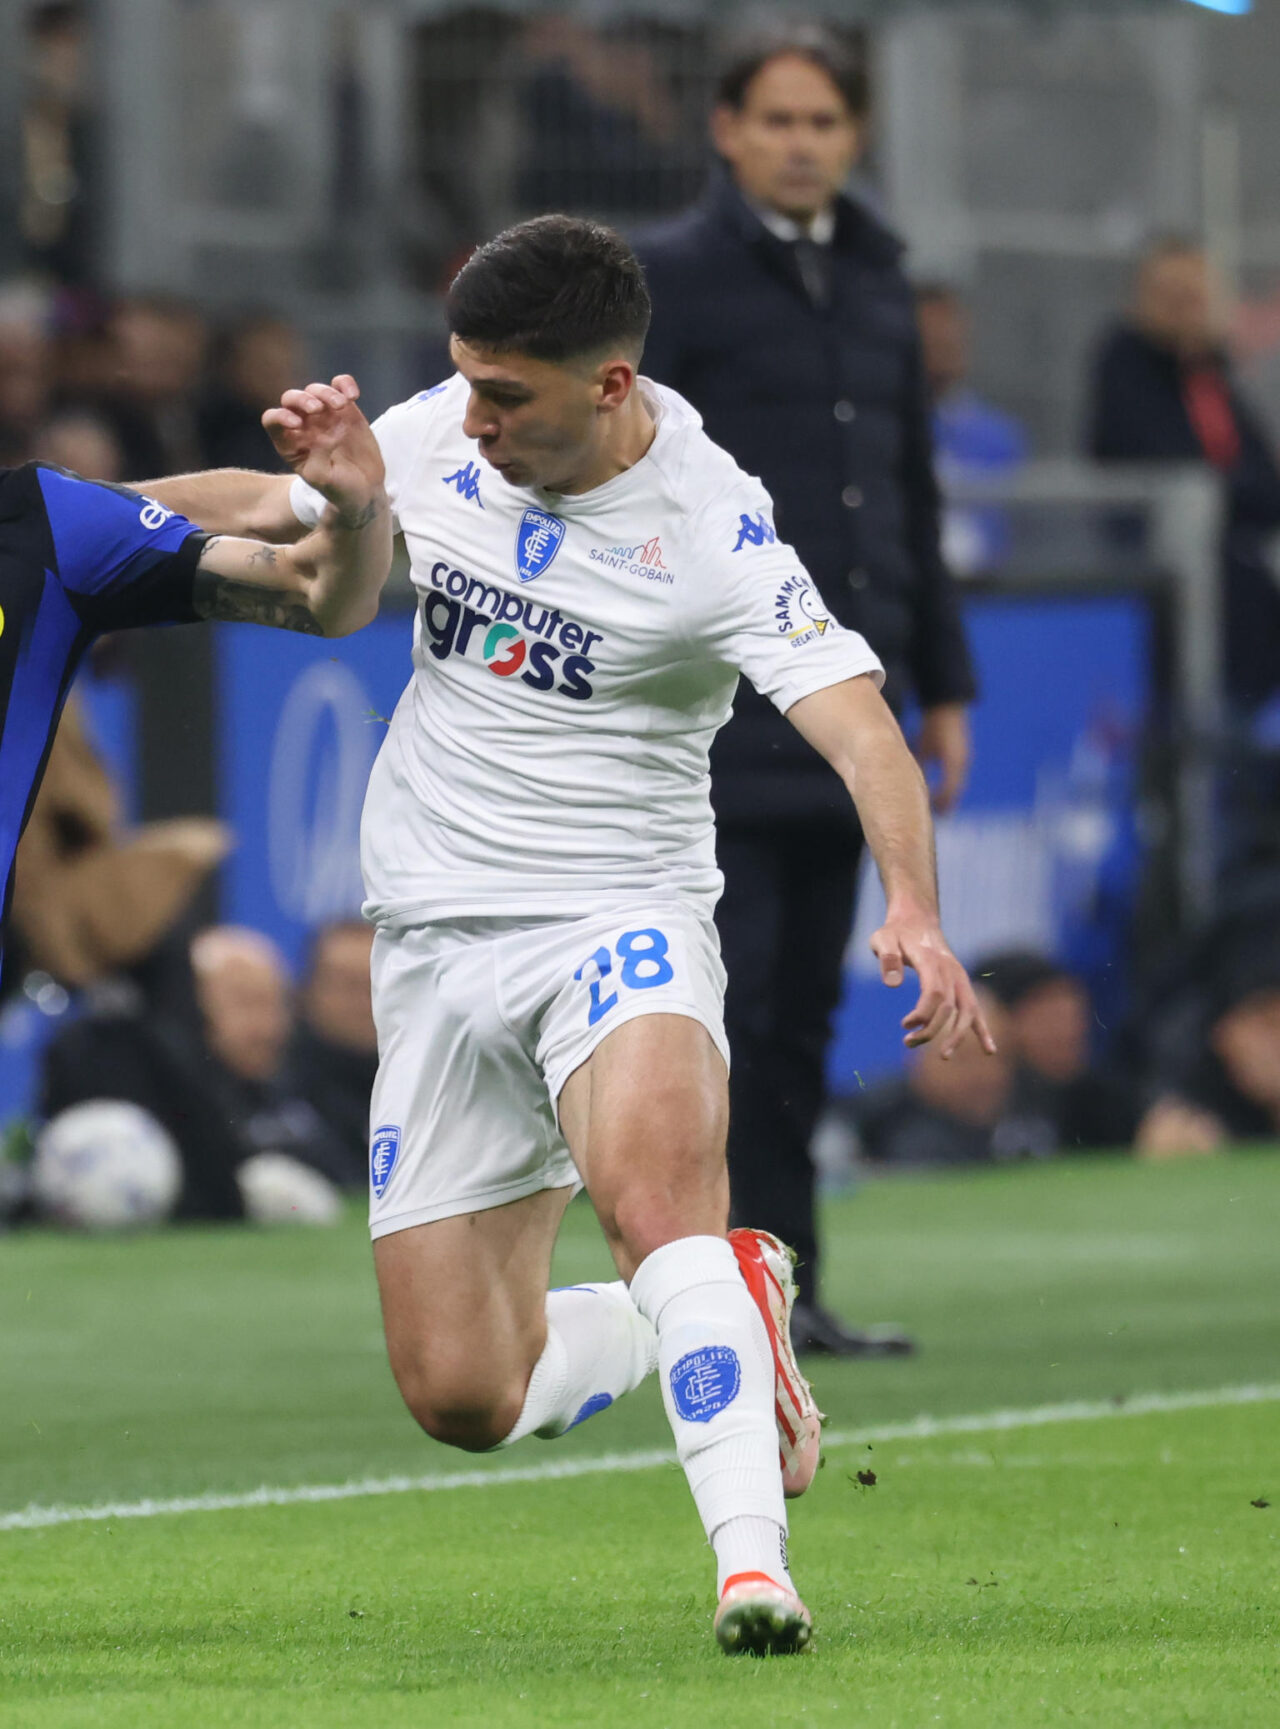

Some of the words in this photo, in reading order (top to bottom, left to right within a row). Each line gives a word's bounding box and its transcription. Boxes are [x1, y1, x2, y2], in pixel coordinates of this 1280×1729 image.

[431, 562, 604, 656] computer
[588, 548, 676, 585] SAINT-GOBAIN
[775, 575, 811, 633] SAMM
[425, 590, 596, 701] gross
[573, 927, 675, 1027] 28
